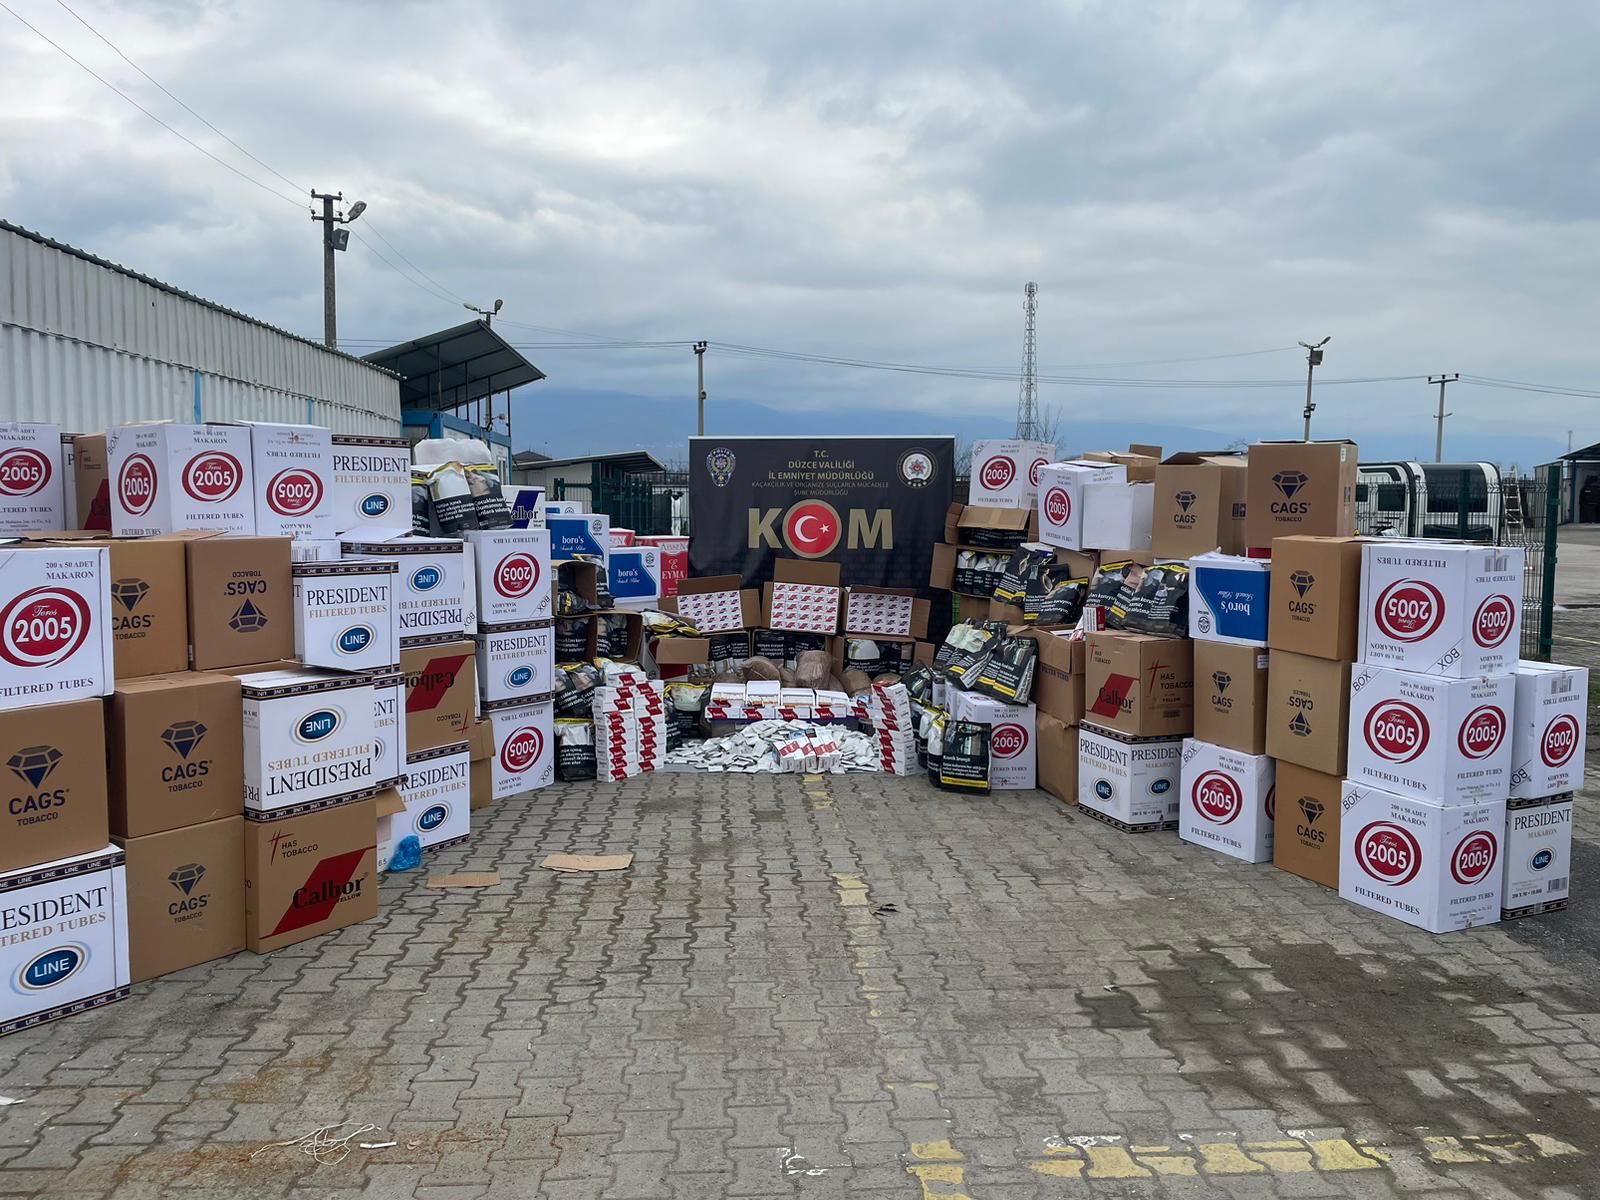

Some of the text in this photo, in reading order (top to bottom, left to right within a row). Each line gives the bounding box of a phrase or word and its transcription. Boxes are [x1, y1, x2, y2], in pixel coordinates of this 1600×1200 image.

[814, 450, 829, 458] T.C.
[333, 455, 408, 473] PRESIDENT
[788, 460, 854, 469] DÜZCE VALİLİĞİ
[1, 467, 39, 480] 2005
[195, 472, 231, 486] 2005
[335, 475, 408, 484] FILTERED TUBES
[778, 472, 815, 480] EMNİYET
[817, 472, 874, 480] MÜDÜRLÜĞÜ
[987, 470, 1008, 480] 2005
[126, 478, 149, 496] 2005
[279, 483, 312, 498] 2005
[366, 500, 387, 510] LINE
[1049, 501, 1065, 515] 2005
[1271, 502, 1308, 513] CAGS
[511, 506, 538, 520] albor
[1174, 514, 1196, 524] CAGS
[1377, 557, 1446, 568] FILTERED TUBES
[46, 571, 94, 580] MAKARON
[233, 570, 262, 578] TOBACCO
[418, 574, 436, 583] LINE
[503, 566, 531, 581] 2005
[618, 569, 638, 577] boro's
[227, 580, 267, 595] CAGS
[307, 586, 388, 605] PRESIDENT
[309, 605, 387, 618] FILTERED TUBES
[538, 596, 550, 612] BOX
[1220, 601, 1250, 615] boro's
[1288, 601, 1314, 614] CAGS
[1388, 598, 1429, 620] 2005
[112, 615, 151, 630] CAGS
[400, 609, 462, 627] PRESIDEN
[464, 612, 475, 627] BOX
[1292, 614, 1310, 622] TOBACCO
[1481, 611, 1506, 627] 2005
[15, 616, 72, 643] 2005
[115, 632, 146, 640] TOBACCO
[345, 634, 365, 645] LINE
[490, 635, 547, 651] PRESIDENT
[492, 649, 547, 661] FILTERED TUBES
[1371, 643, 1404, 653] MAKARON
[1438, 648, 1460, 669] BOX
[514, 671, 528, 680] LINE
[1352, 672, 1371, 692] BOX
[0, 678, 93, 696] FILTERED TUBES
[1161, 681, 1194, 689] TOBACCO
[1098, 688, 1133, 710] Calbor
[1212, 696, 1232, 708] CAGS
[1289, 696, 1313, 710] CAGS
[1400, 689, 1435, 702] MAKARON
[306, 719, 331, 732] LINE
[1377, 720, 1415, 746] 2005
[993, 736, 1020, 748] 2005
[1469, 726, 1496, 744] 2005
[1549, 729, 1571, 748] 2005
[510, 738, 535, 756] 2005
[1080, 738, 1128, 767] PRESIDENT
[1131, 746, 1182, 761] PRESIDEN
[268, 744, 369, 771] FILTERED TUBES
[1183, 747, 1197, 763] BOX
[161, 760, 209, 783] CAGS
[540, 764, 552, 782] BOX
[1080, 755, 1127, 777] FILTERED TUBES
[1219, 762, 1245, 773] MAKARON
[267, 758, 372, 796] PRESIDENT
[401, 762, 467, 790] RESIDENT
[1363, 768, 1427, 791] FILTERED TUBES
[1457, 768, 1503, 780] FILTERED TUBES
[168, 780, 203, 793] TOBACCO
[1154, 783, 1168, 791] LINE
[8, 789, 66, 816] CAGS
[1202, 788, 1232, 810] 2005
[1342, 792, 1361, 810] BOX
[17, 812, 58, 827] TOBACCO
[424, 811, 442, 824] LINE
[1391, 812, 1427, 827] MAKARON
[1514, 809, 1571, 831] PRESIDENT
[1191, 827, 1242, 848] FILTERED TUBES
[1297, 825, 1325, 842] CAGS
[1528, 828, 1557, 839] MAKARON
[282, 840, 297, 849] HAS
[282, 844, 318, 859] TOBACCO
[1300, 840, 1320, 849] TOBACCO
[1368, 841, 1407, 869] 2005
[1461, 852, 1488, 870] 2005
[1535, 855, 1549, 864] LINE
[293, 876, 366, 909] Calbor
[1450, 892, 1494, 905] FILTERED TUBES
[168, 894, 208, 916] CAGS
[1355, 886, 1420, 916] FILTERED TUBES
[0, 887, 107, 931] ESIDENT
[174, 911, 203, 924] TOBACCO
[0, 912, 106, 946] TERED TUBES
[35, 957, 69, 978] LINE
